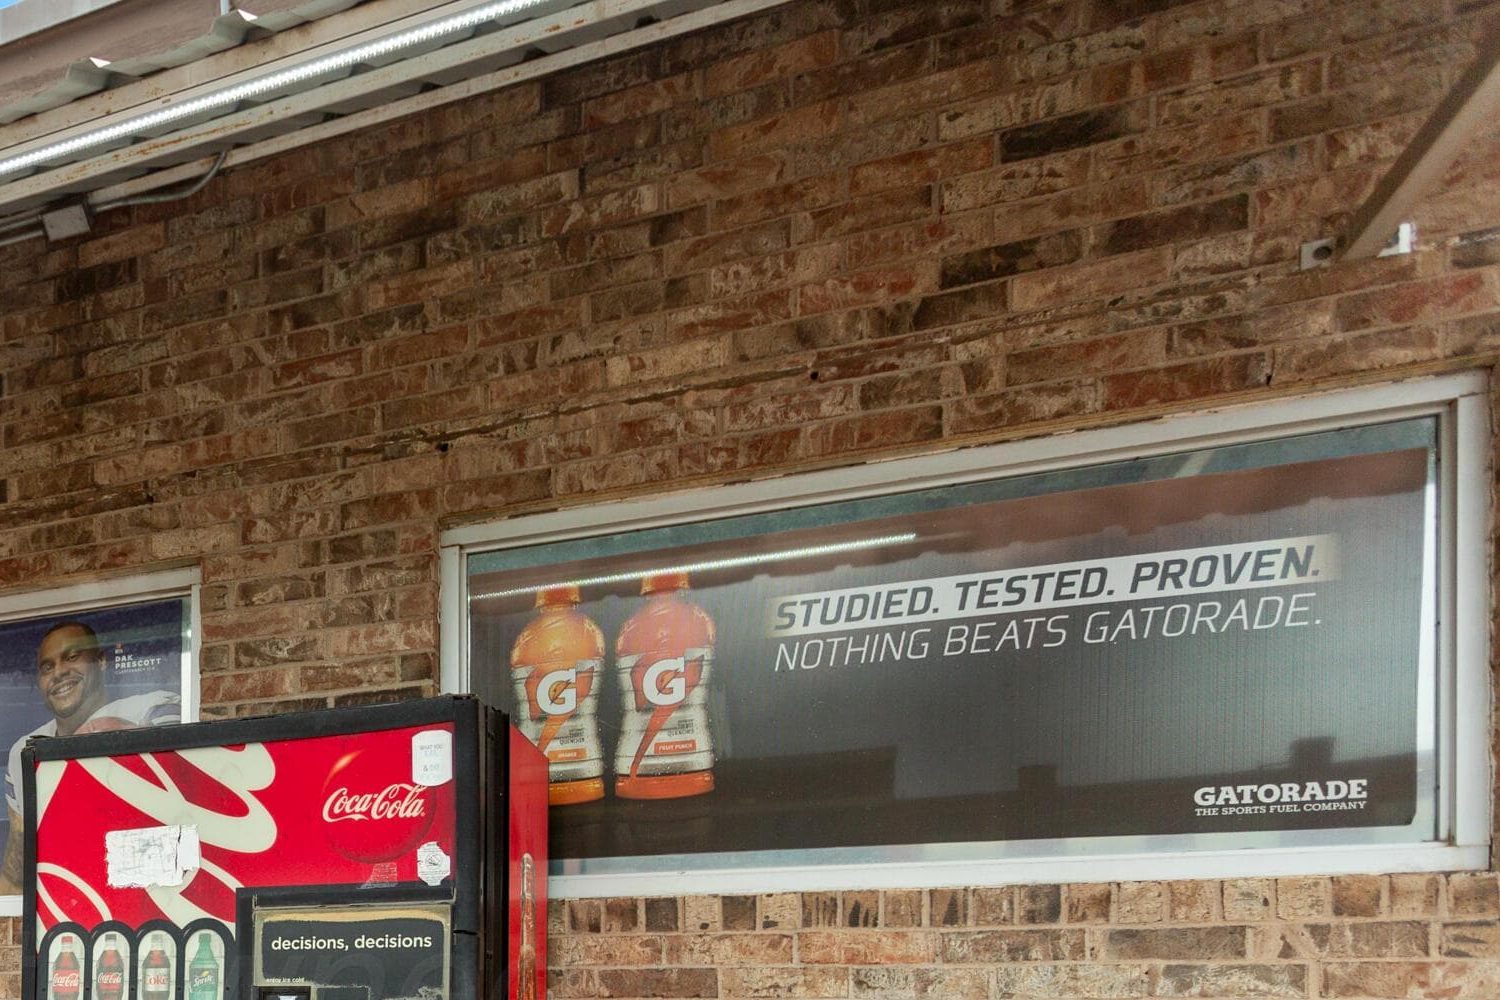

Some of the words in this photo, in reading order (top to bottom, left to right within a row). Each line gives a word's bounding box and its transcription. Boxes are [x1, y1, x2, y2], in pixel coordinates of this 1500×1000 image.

[774, 586, 939, 630] STUDIED.
[955, 566, 1115, 611] TESTED.
[1129, 545, 1320, 593] PROVEN.
[774, 628, 931, 672] NOTHING
[943, 614, 1070, 656] BEATS
[1084, 592, 1321, 644] GATORADE.
[115, 658, 161, 669] PRESCOTT
[643, 657, 686, 705] G
[537, 669, 577, 715] G
[322, 783, 427, 823] Coca-Cola
[1194, 779, 1368, 806] GATORADE
[1195, 808, 1219, 816] THE
[1222, 806, 1266, 814] SPORTS
[1269, 804, 1300, 813] FUEL
[1303, 801, 1367, 812] COMPANY
[271, 936, 349, 951] decisions,
[354, 934, 432, 949] decisions
